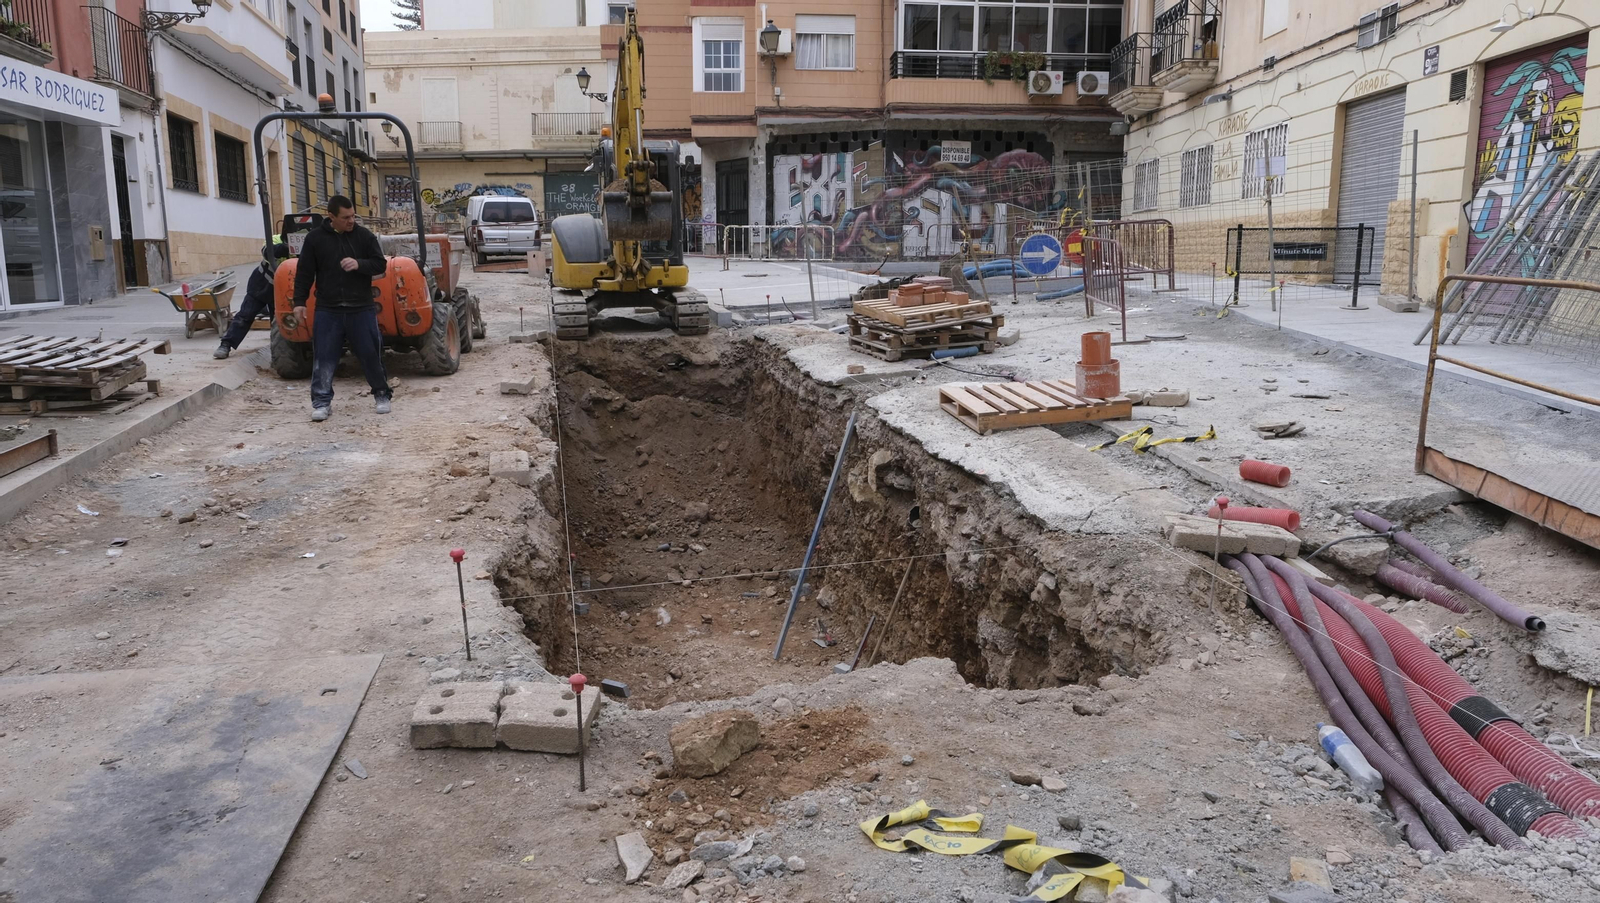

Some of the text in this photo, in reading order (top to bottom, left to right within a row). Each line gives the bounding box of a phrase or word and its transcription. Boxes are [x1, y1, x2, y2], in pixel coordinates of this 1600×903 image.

[0, 66, 106, 112] SAR RODRIGUEZ
[1353, 73, 1390, 97] KARAOKE
[1218, 111, 1248, 137] KARAOKE
[942, 153, 950, 161] 950
[1222, 141, 1232, 157] LA
[546, 192, 567, 203] THE
